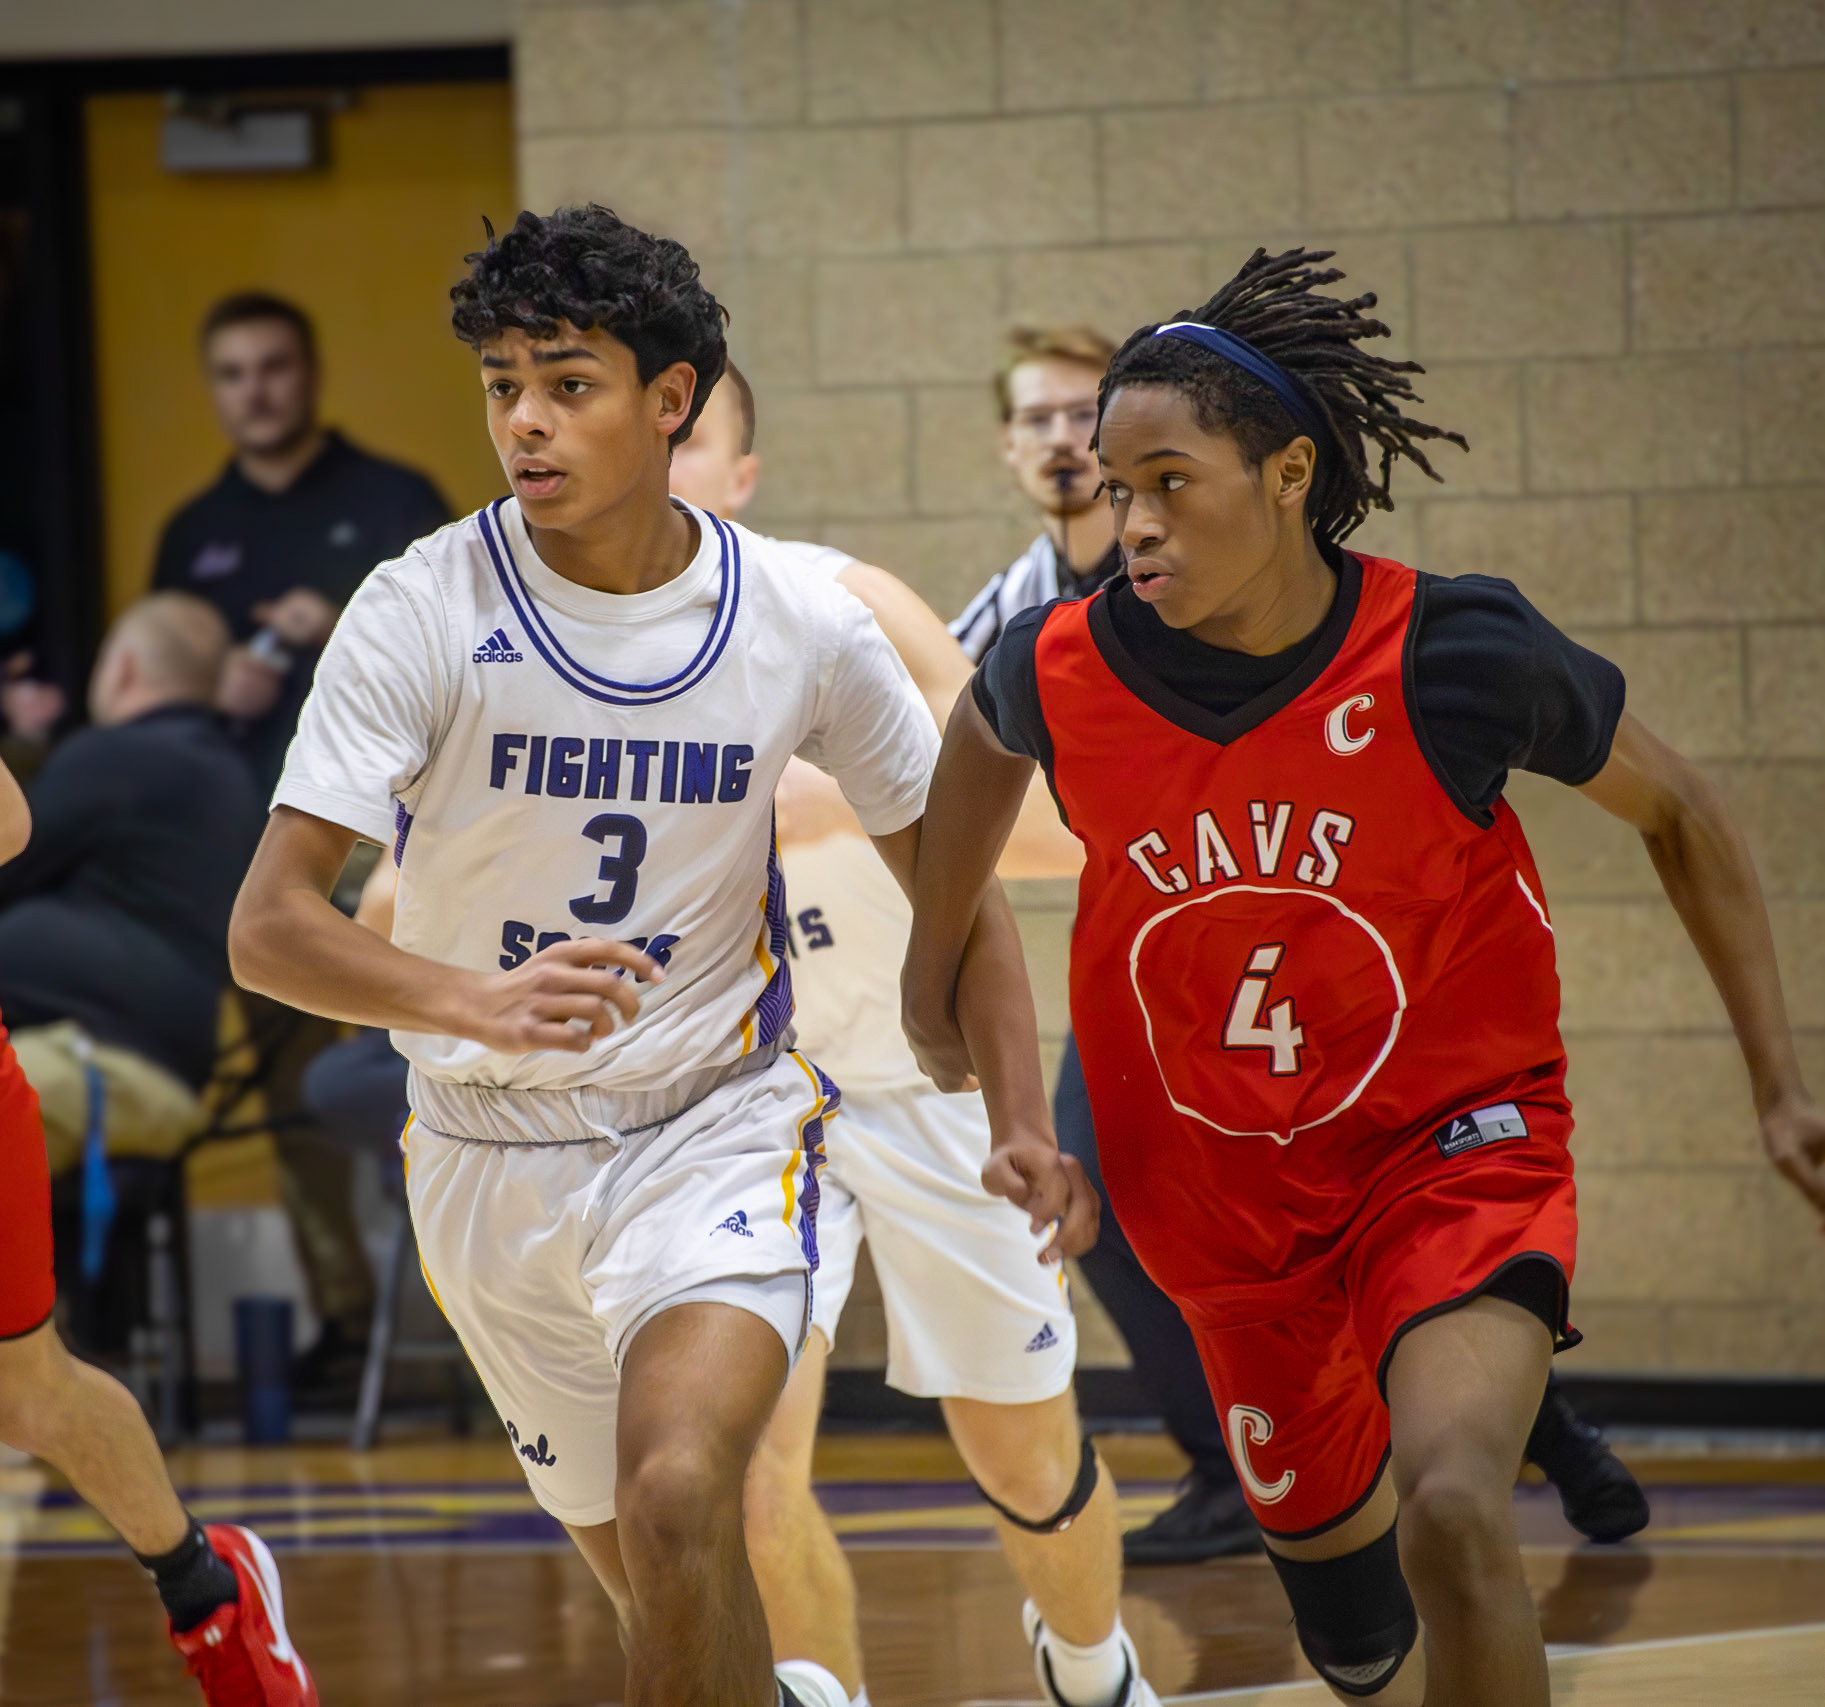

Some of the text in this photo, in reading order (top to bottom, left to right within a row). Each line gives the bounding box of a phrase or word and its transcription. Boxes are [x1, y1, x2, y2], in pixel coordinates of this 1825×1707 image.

[472, 650, 523, 663] adidas
[1325, 693, 1375, 756] C
[489, 733, 754, 804] FIGHTING
[568, 813, 648, 925] 3
[1126, 800, 1355, 894] CAVS
[1221, 942, 1305, 1077] 4
[1499, 1122, 1510, 1133] L
[1228, 1404, 1296, 1505] C
